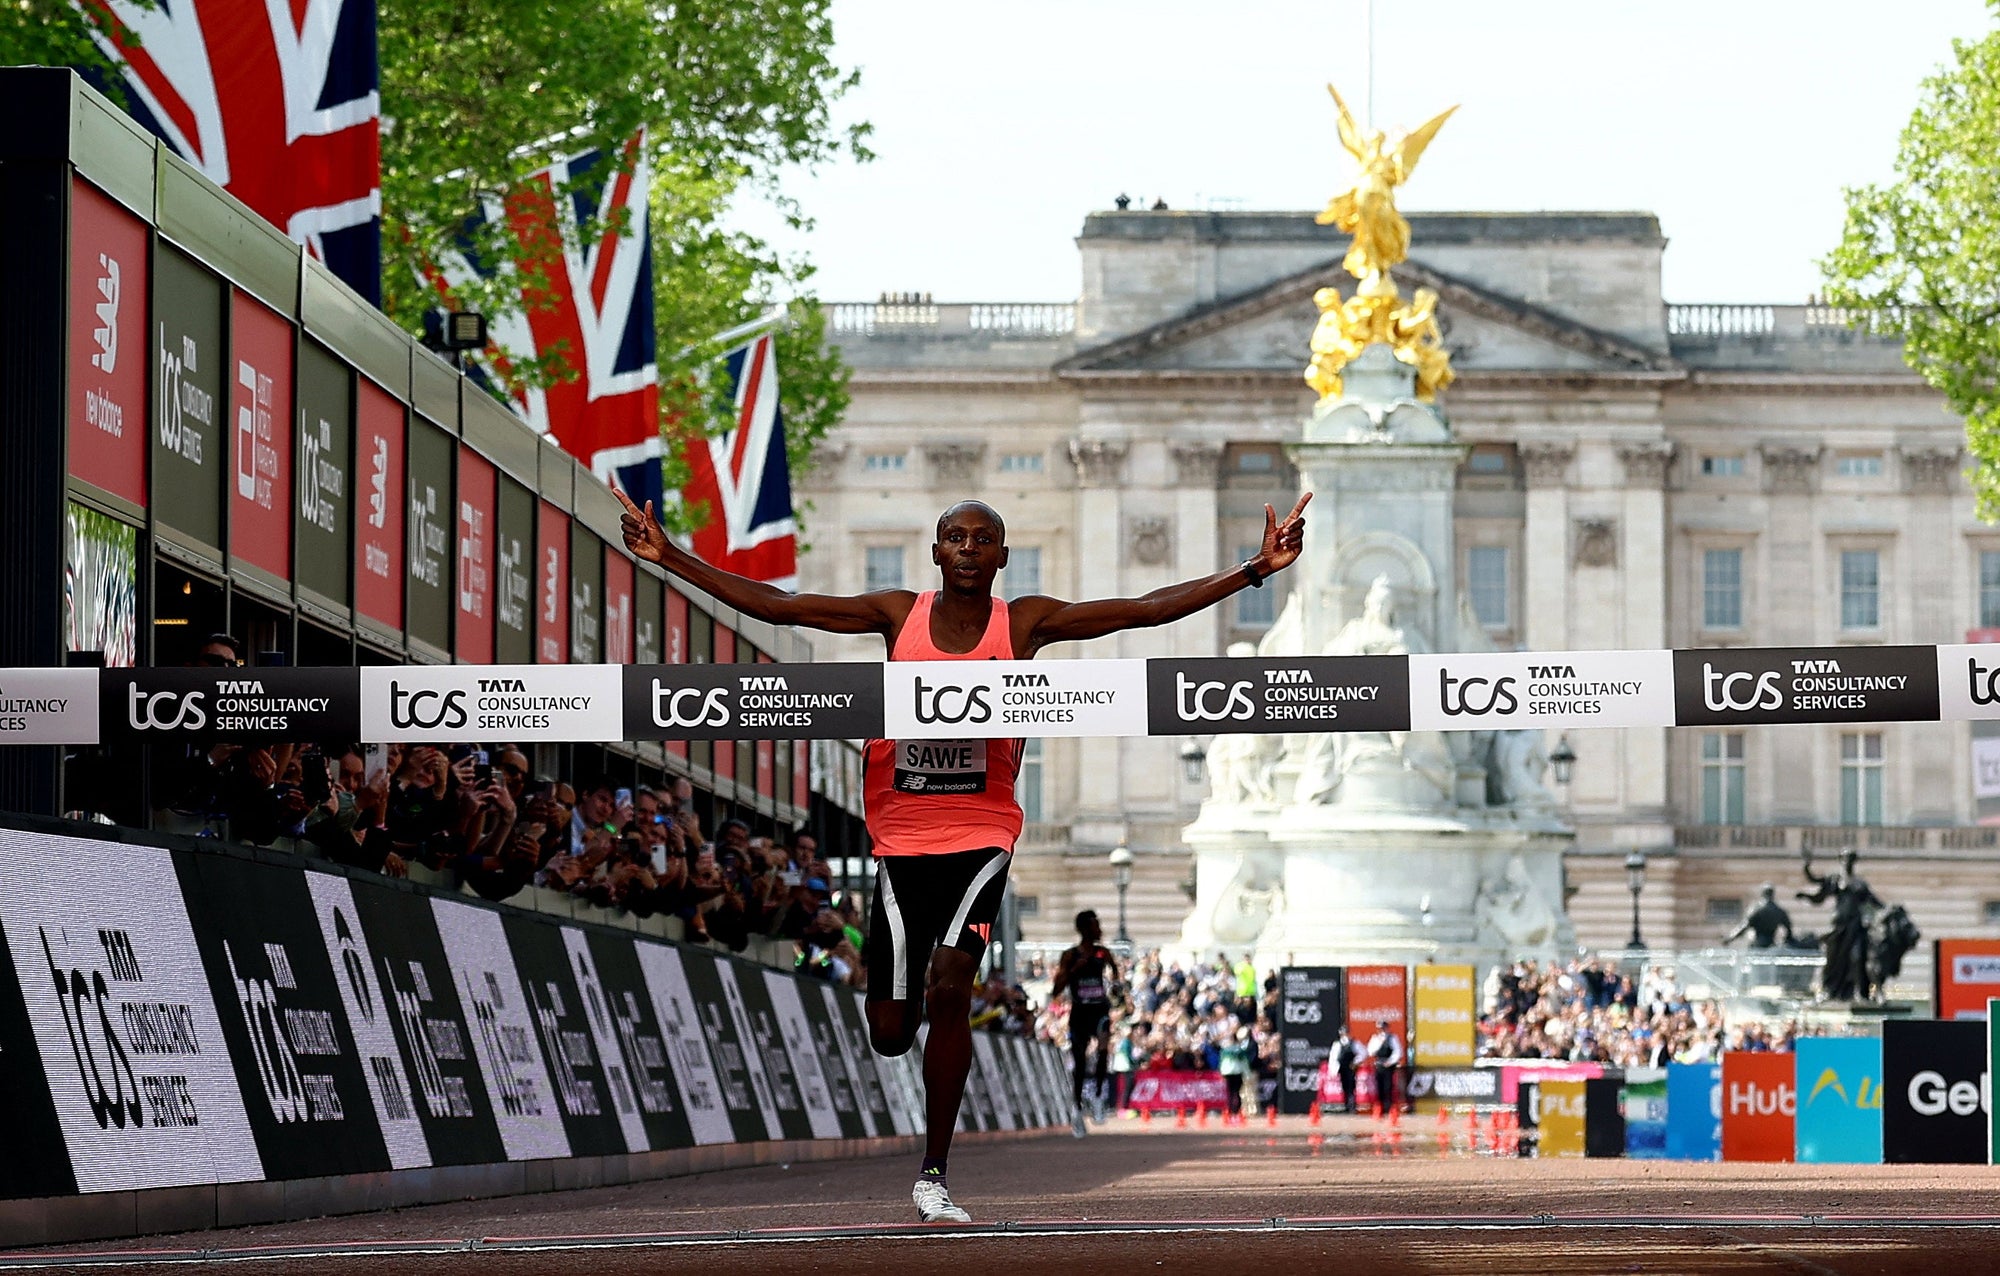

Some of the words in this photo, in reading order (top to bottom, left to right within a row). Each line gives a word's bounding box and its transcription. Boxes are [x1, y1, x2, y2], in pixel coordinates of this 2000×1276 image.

[160, 321, 182, 453] tcs
[1528, 666, 1576, 678] TATA
[1791, 660, 1841, 674] TATA
[739, 677, 788, 690] TATA
[1002, 674, 1050, 687] TATA
[1264, 669, 1313, 683] TATA
[216, 681, 264, 694] TATA
[478, 680, 526, 693] TATA
[1528, 682, 1642, 697] CONSULTANCY
[1703, 662, 1783, 712] tcs
[1791, 676, 1907, 692] CONSULTANCY
[1002, 691, 1116, 705] CONSULTANCY
[1177, 671, 1255, 721] tcs
[1264, 686, 1379, 701] CONSULTANCY
[1440, 668, 1518, 716] tcs
[129, 681, 206, 730] tcs
[216, 698, 330, 712] CONSULTANCY
[391, 680, 468, 729] tcs
[478, 697, 591, 711] CONSULTANCY
[652, 678, 730, 727] tcs
[739, 694, 853, 708] CONSULTANCY
[915, 676, 992, 724] tcs
[1793, 695, 1866, 710] SERVICES
[1264, 705, 1337, 720] SERVICES
[1529, 701, 1601, 715] SERVICES
[216, 717, 288, 730] SERVICES
[478, 715, 550, 729] SERVICES
[739, 712, 812, 726] SERVICES
[1002, 709, 1075, 723] SERVICES
[906, 743, 973, 768] SAWE
[945, 783, 977, 791] balance
[98, 928, 143, 982] TATA
[263, 943, 298, 989] TATA
[1284, 998, 1322, 1024] tcs
[39, 926, 143, 1129] tcs
[122, 1003, 200, 1055] CONSULTANCY
[223, 939, 308, 1123] tcs
[285, 1008, 341, 1055] CONSULTANCY
[384, 956, 451, 1118] tcs
[142, 1075, 198, 1127] SERVICES
[302, 1075, 344, 1121] SERVICES
[1730, 1082, 1796, 1116] Hub
